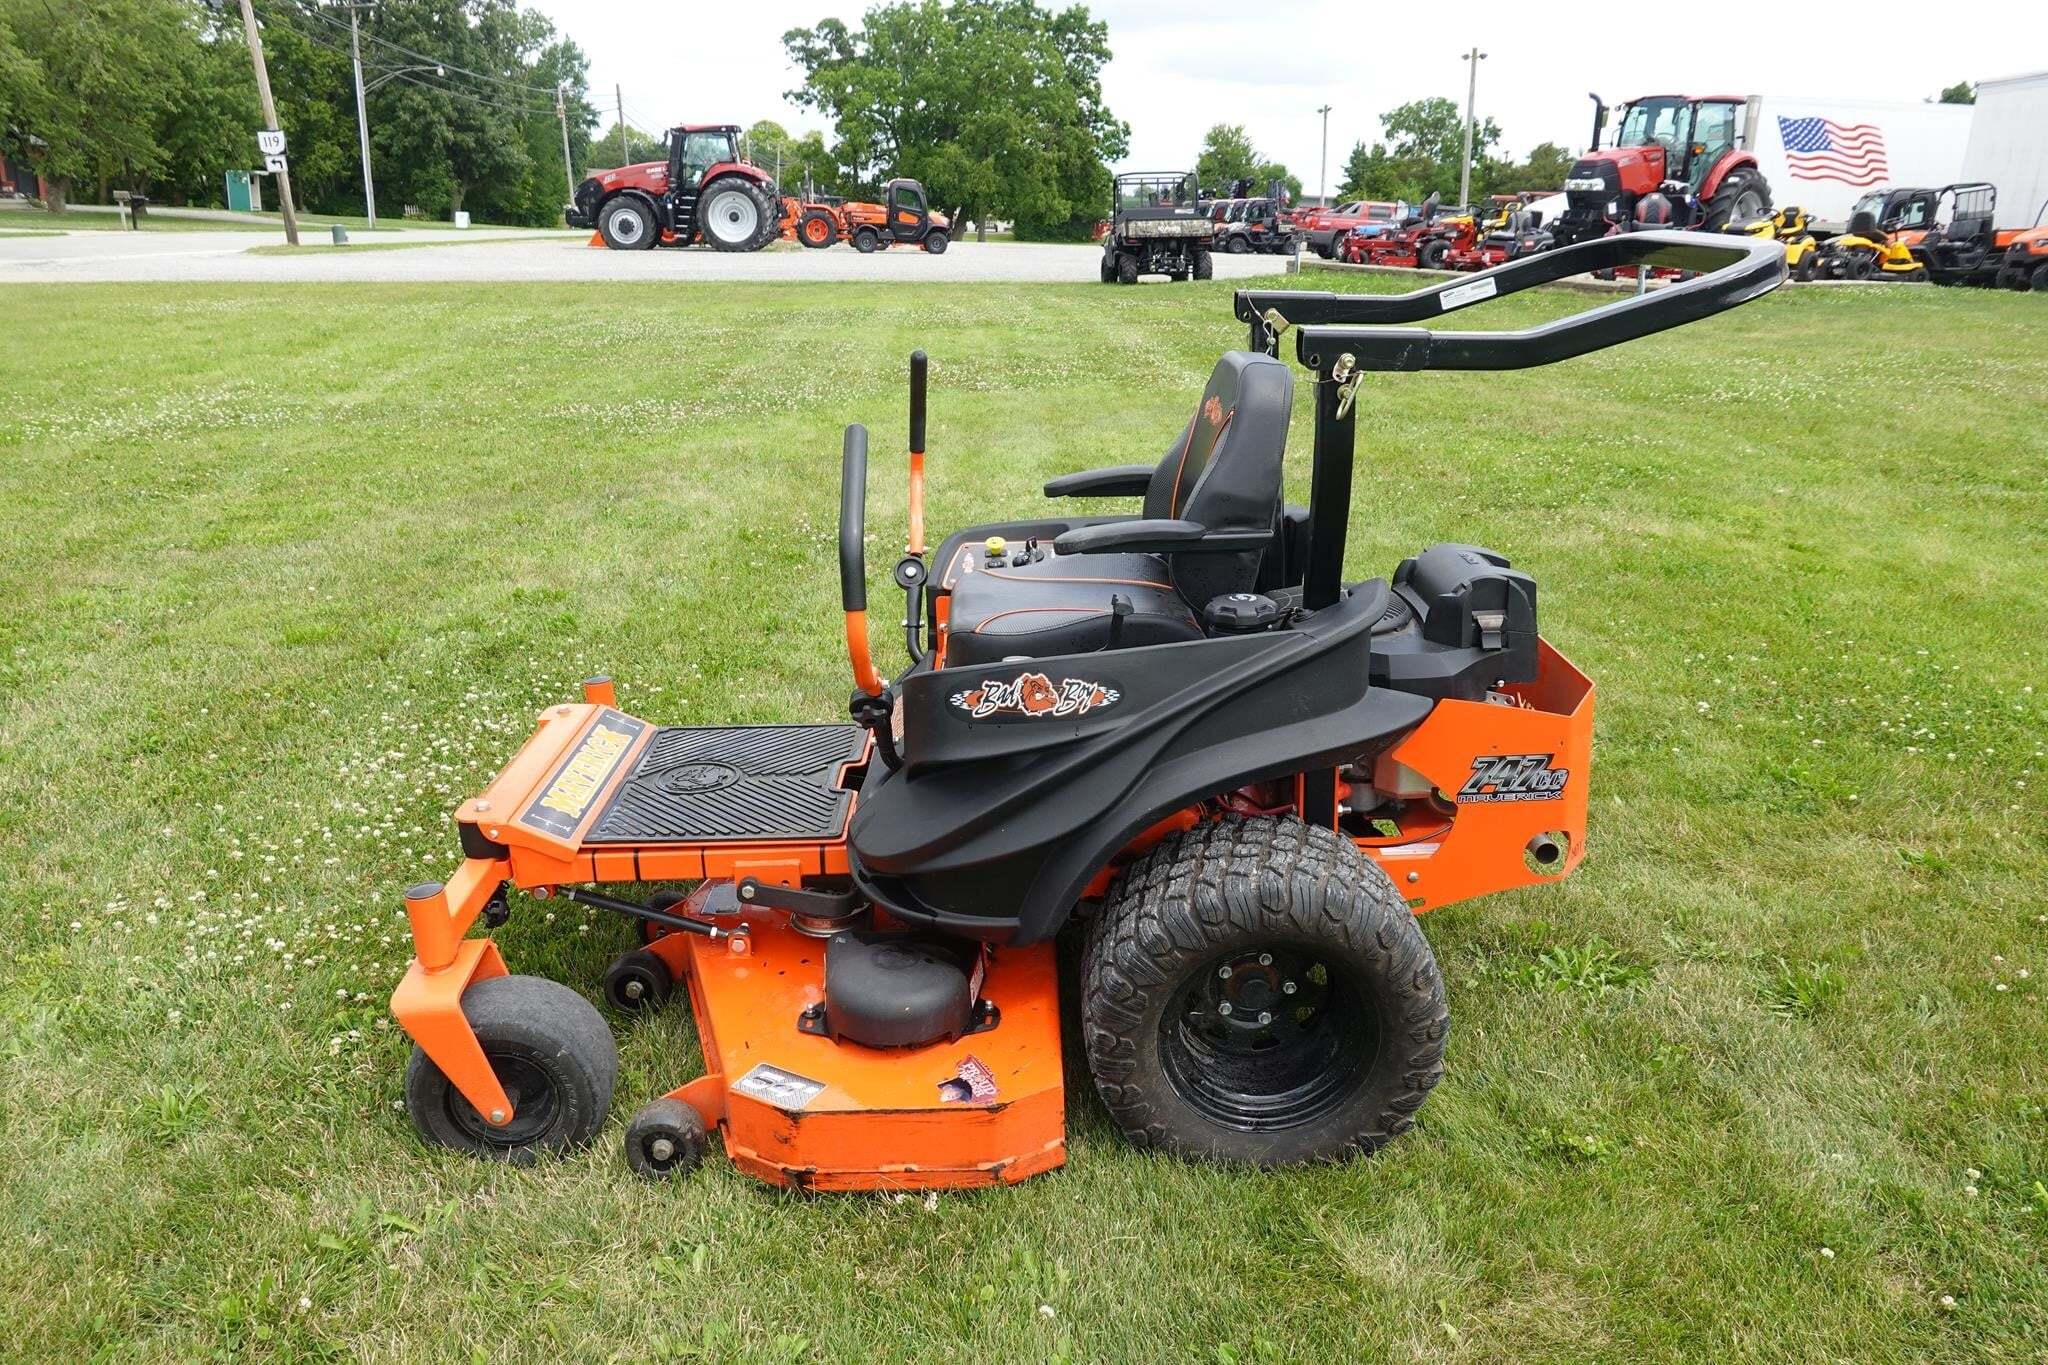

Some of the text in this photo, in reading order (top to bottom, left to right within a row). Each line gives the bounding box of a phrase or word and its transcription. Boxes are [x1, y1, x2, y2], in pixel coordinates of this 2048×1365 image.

[263, 136, 280, 148] 119
[972, 678, 1098, 718] Bad Boy
[1457, 790, 1563, 804] MAVERICK
